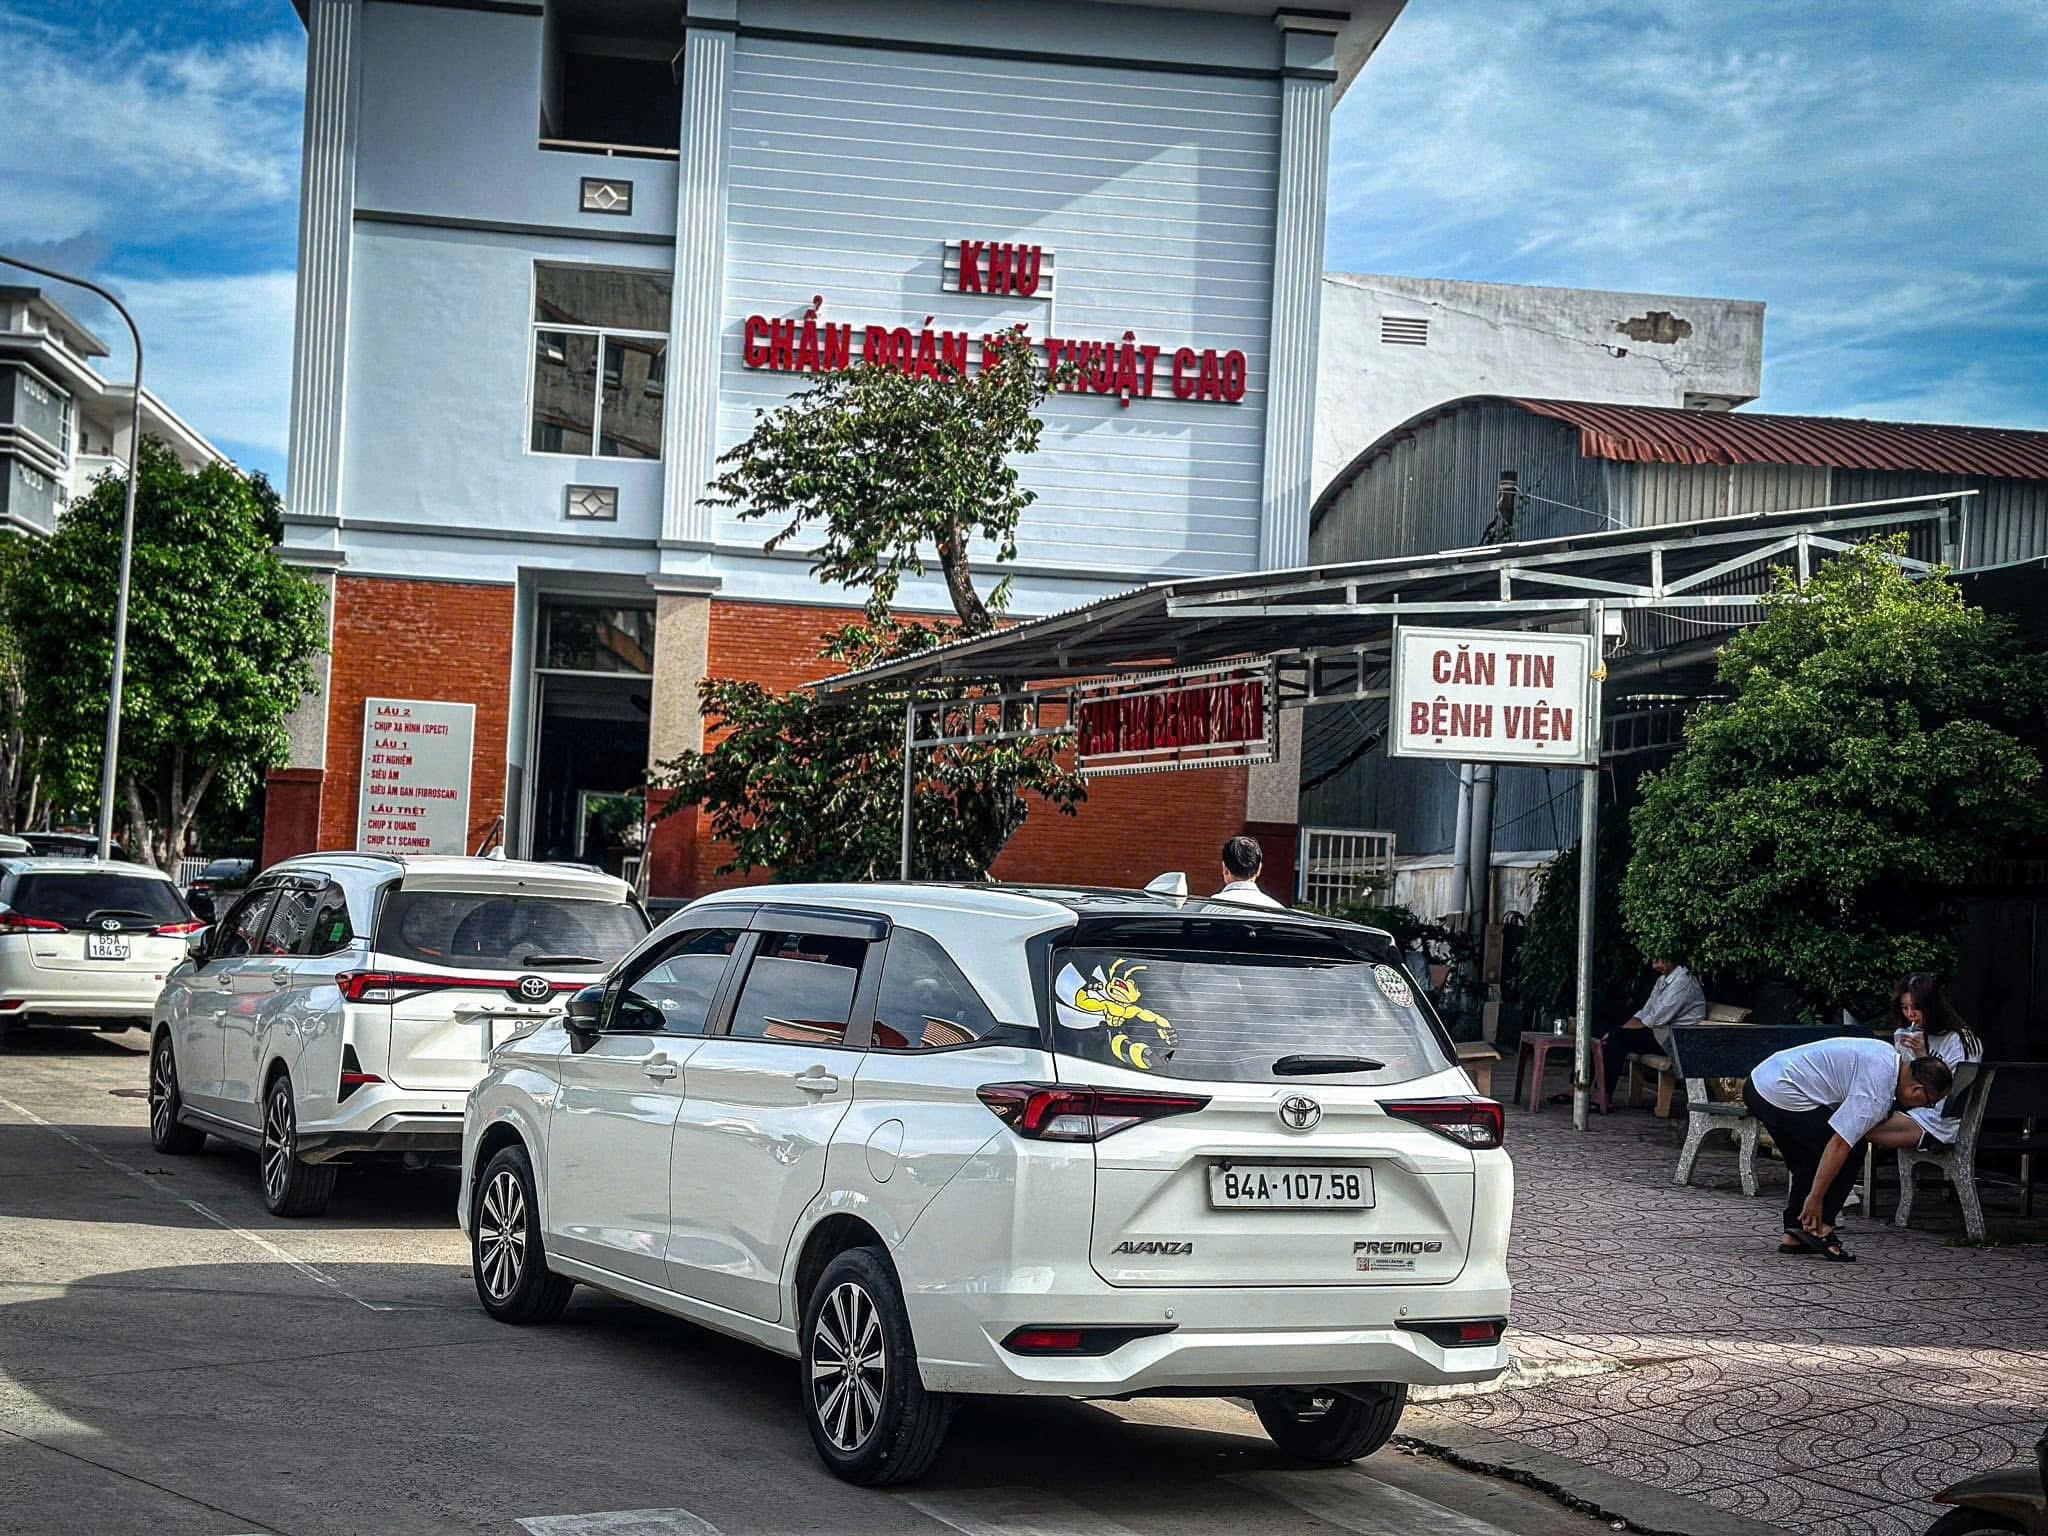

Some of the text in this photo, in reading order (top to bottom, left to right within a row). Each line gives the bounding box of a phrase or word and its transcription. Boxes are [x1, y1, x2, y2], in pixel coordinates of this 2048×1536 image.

[958, 239, 1042, 297] KHU
[744, 295, 851, 373] CHẨN
[1172, 346, 1246, 401] CAO
[1432, 643, 1555, 689] CĂN TIN
[403, 708, 411, 717] 2
[1410, 695, 1573, 748] BỆNH VIỆN
[388, 820, 393, 830] X
[398, 836, 431, 848] SCANNER
[1224, 1173, 1361, 1201] 84A-107.58
[1111, 1241, 1193, 1256] AVANZA
